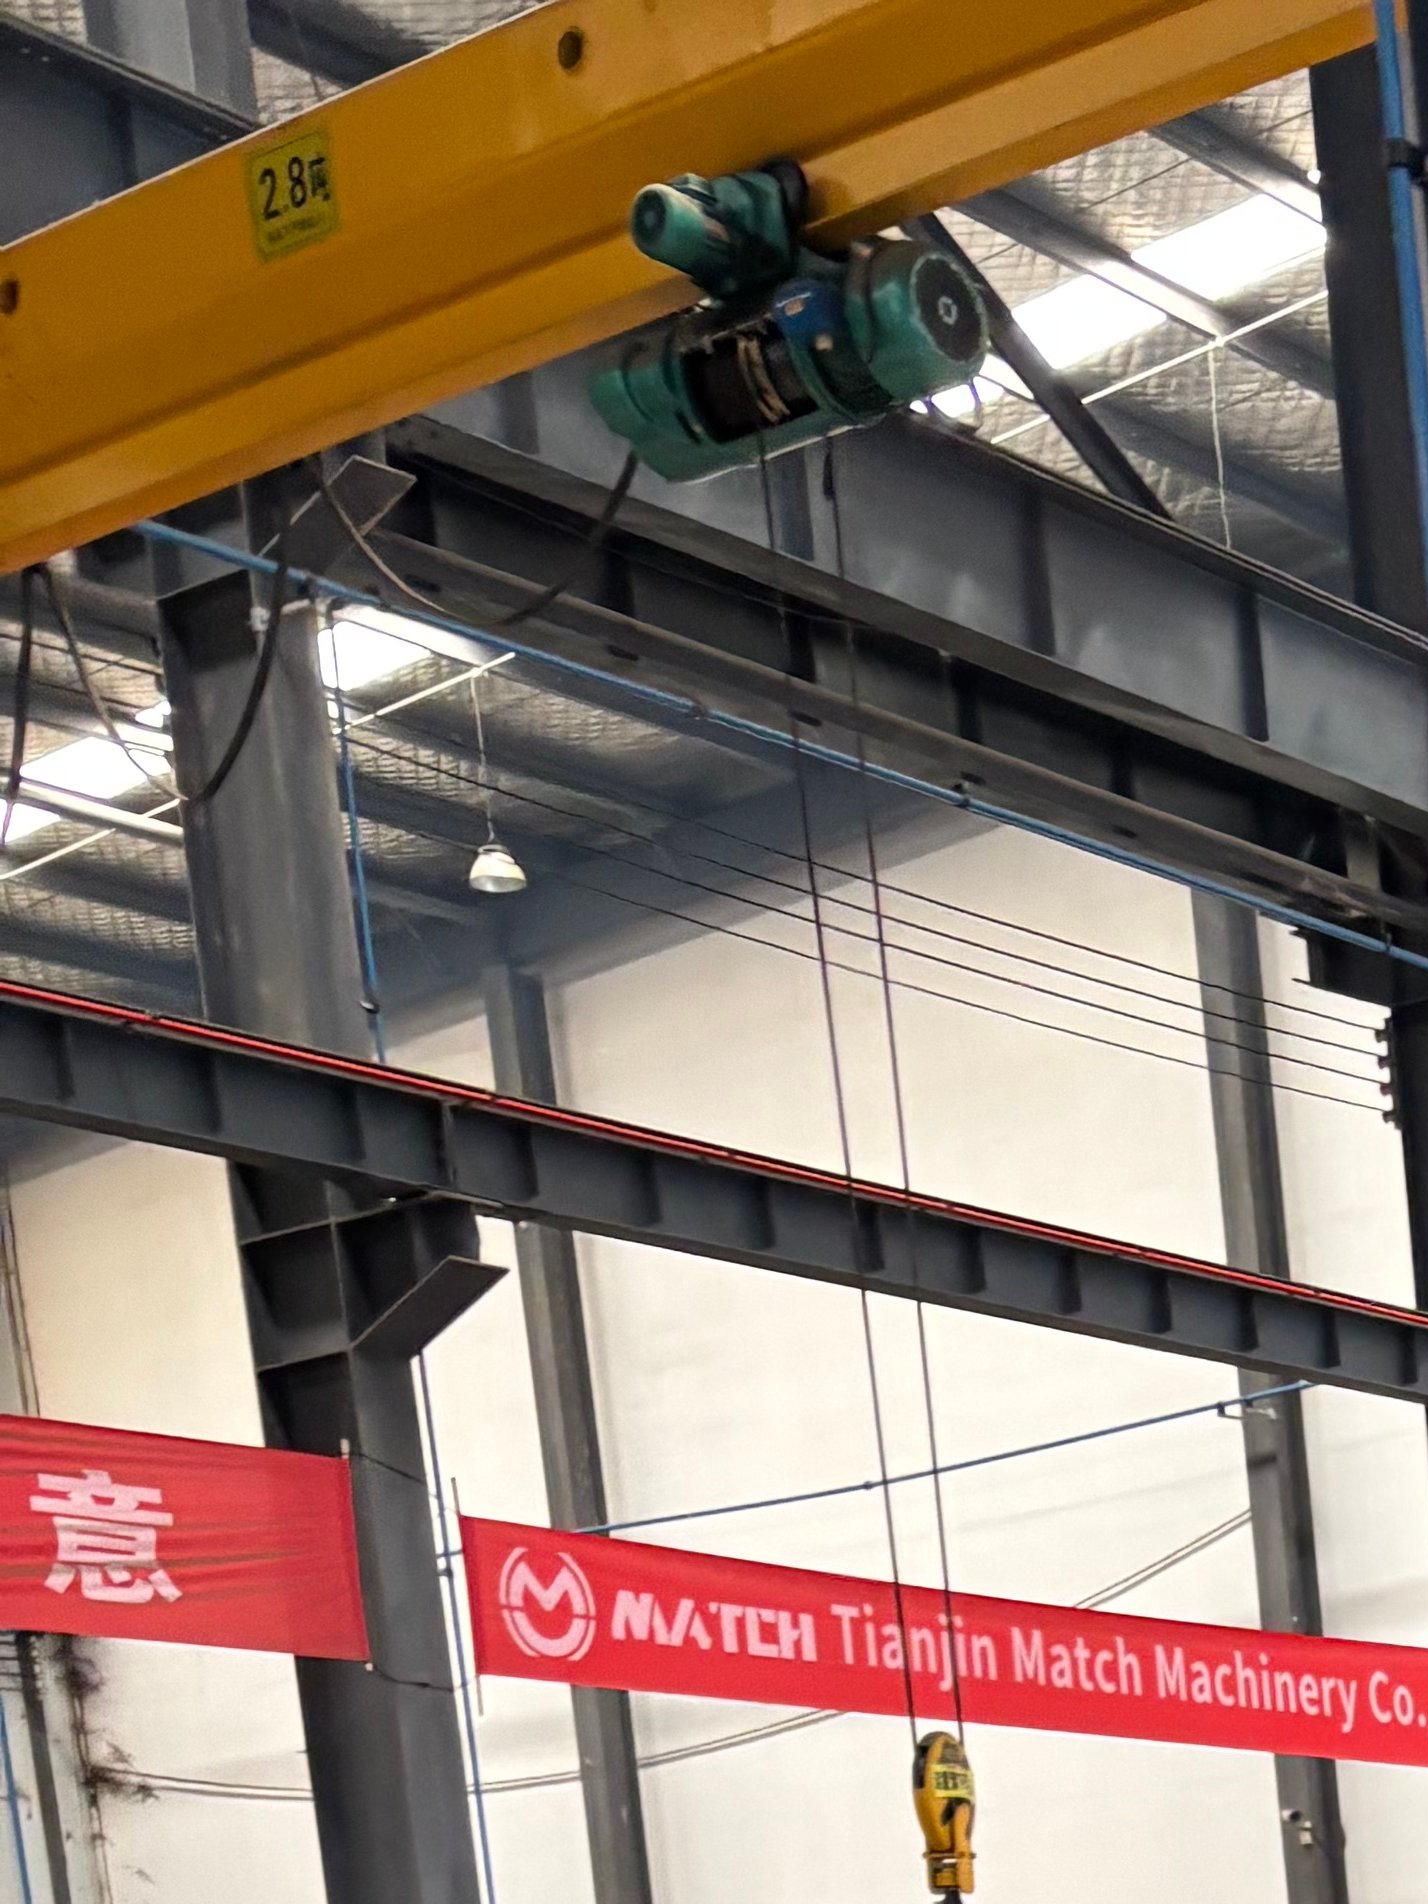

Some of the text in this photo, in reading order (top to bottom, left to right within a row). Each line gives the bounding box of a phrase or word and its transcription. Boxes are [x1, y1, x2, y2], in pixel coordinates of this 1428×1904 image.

[29, 1469, 183, 1604] 意
[610, 1590, 818, 1662] MATCH
[830, 1602, 998, 1692] Tianjin
[1010, 1626, 1143, 1697] Match
[1154, 1643, 1358, 1733] Machinery
